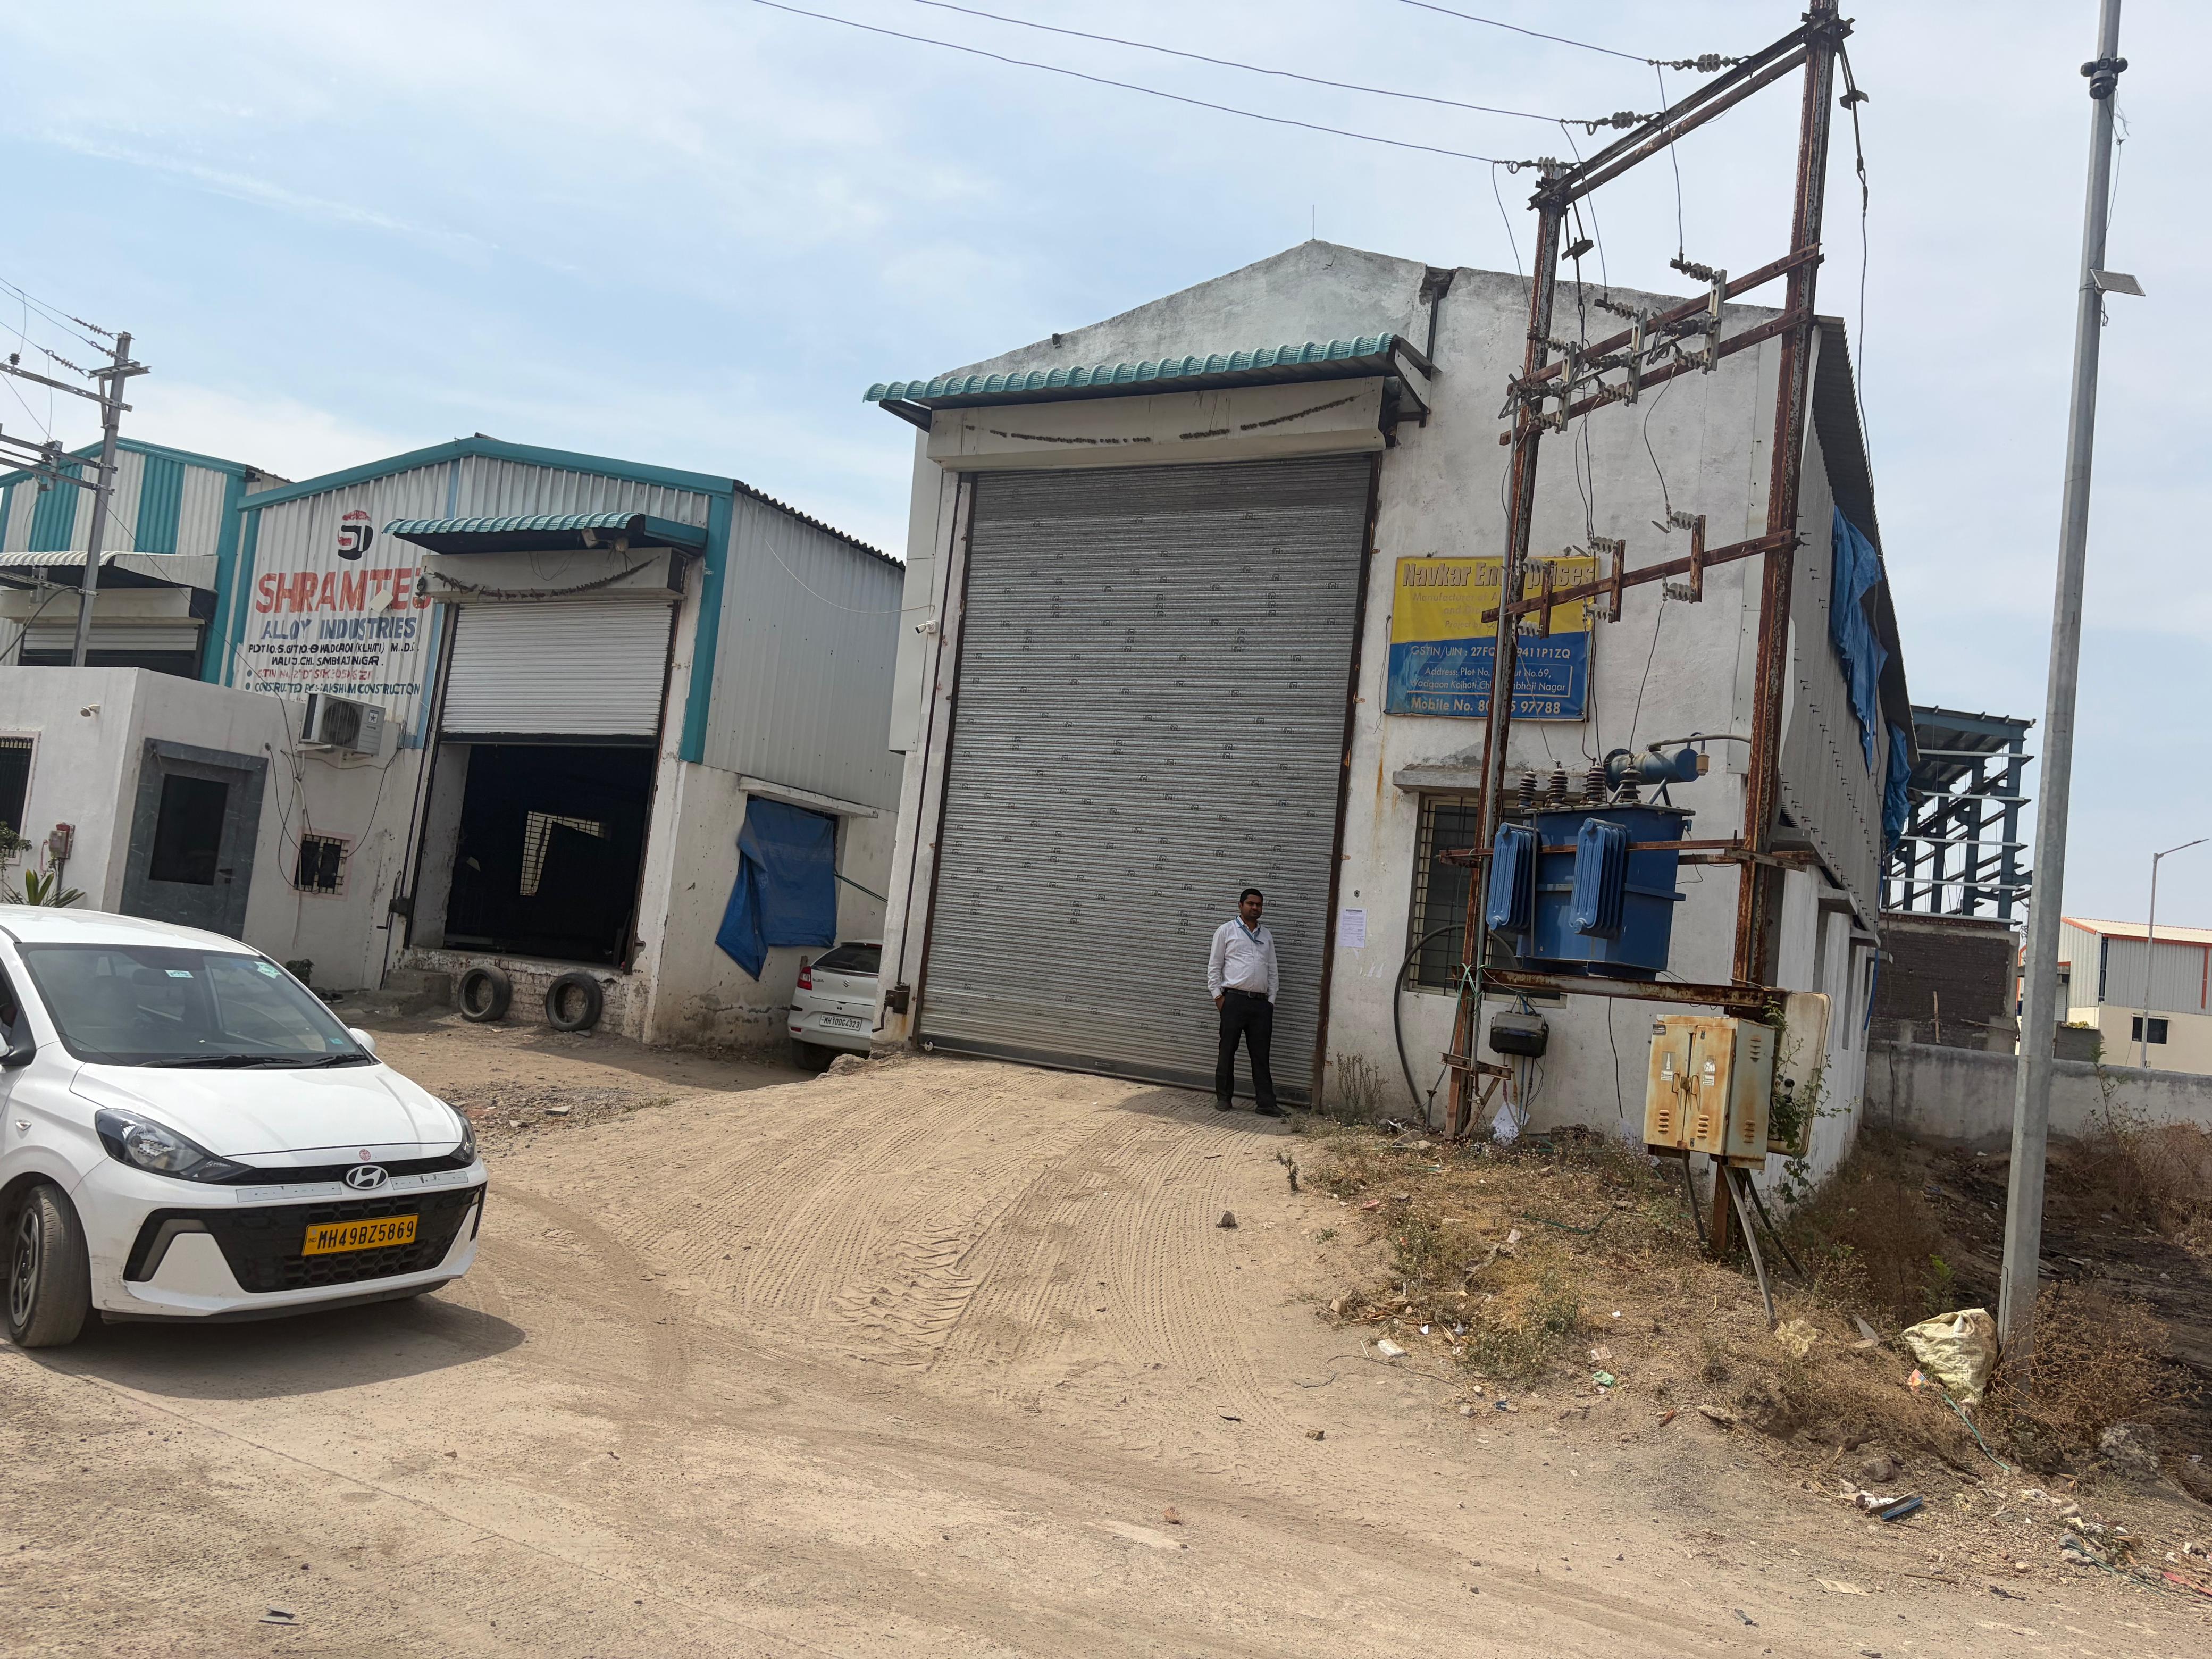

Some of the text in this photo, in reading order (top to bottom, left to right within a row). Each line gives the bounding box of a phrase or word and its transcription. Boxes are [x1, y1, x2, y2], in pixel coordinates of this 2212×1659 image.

[1403, 562, 1472, 586] Navkar
[1413, 592, 1475, 602] Manufacturer
[261, 616, 417, 641] ALLOY INDUSTRIES
[1411, 645, 1462, 659] GSTIN/UIN
[1425, 667, 1459, 676] Address:
[1461, 667, 1475, 676] Plot
[1410, 679, 1448, 690] Wadgaon
[1451, 680, 1477, 690] Kolhati
[1538, 682, 1566, 693] Nagar
[1411, 697, 1449, 710] Mobile
[1453, 699, 1473, 711] No.
[1521, 701, 1561, 715] 97788
[317, 1220, 414, 1250] MH49BZ5869
